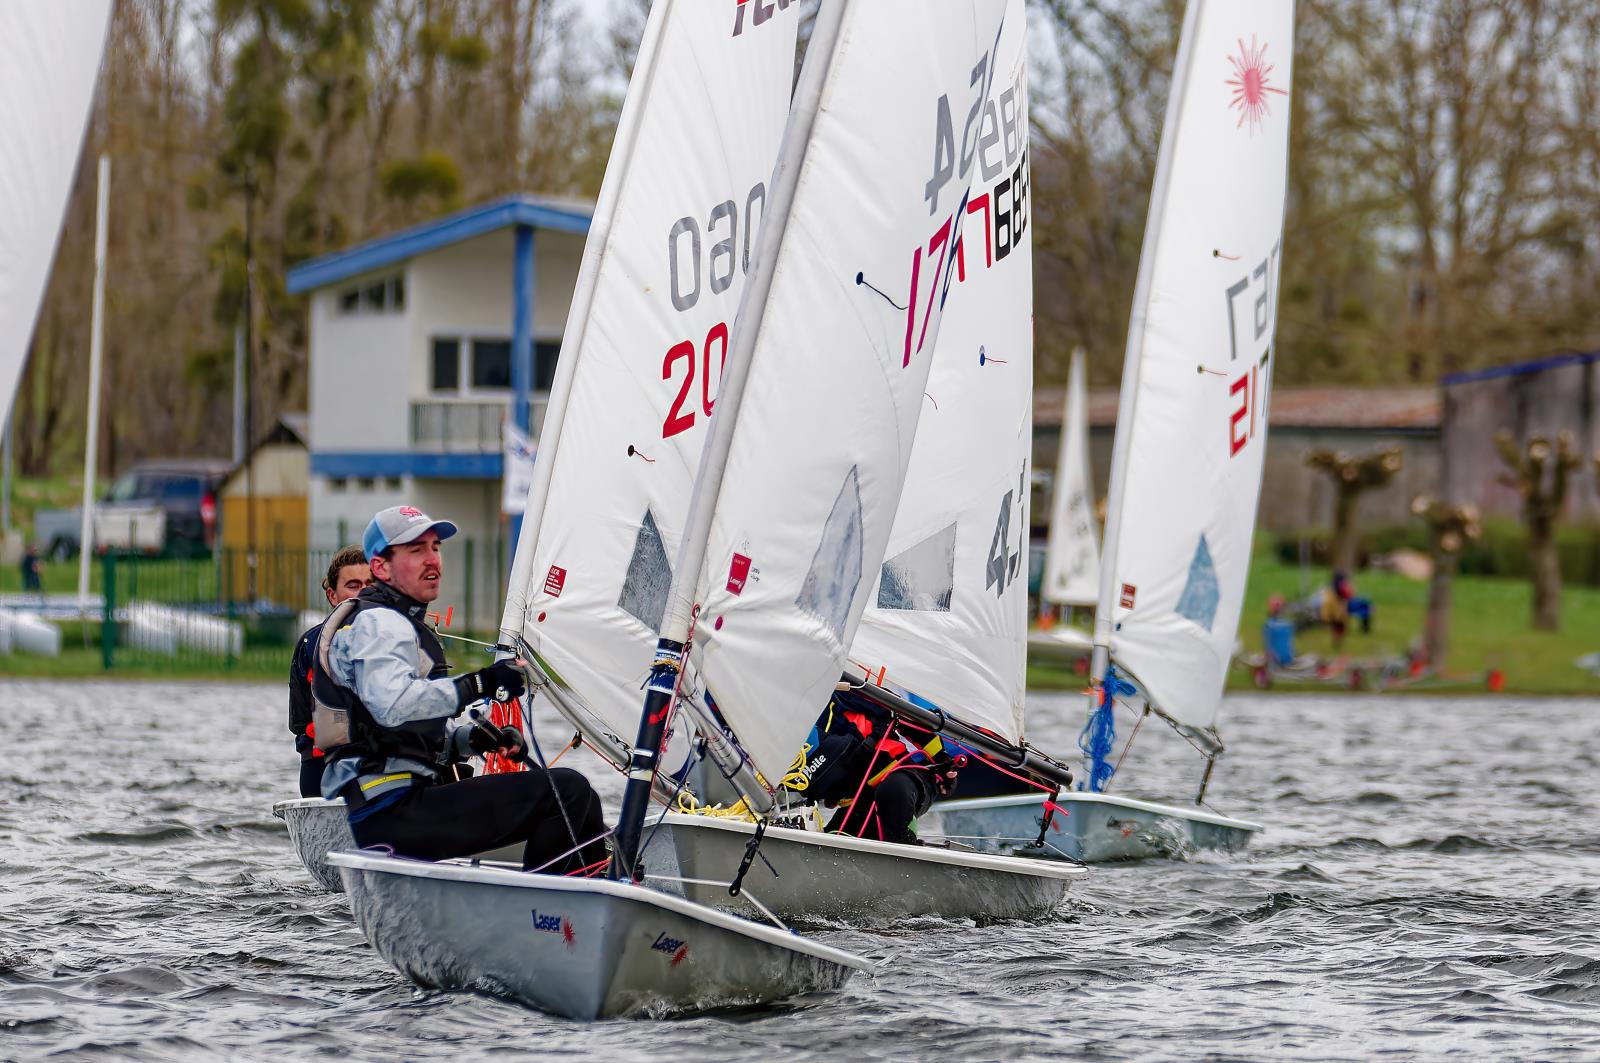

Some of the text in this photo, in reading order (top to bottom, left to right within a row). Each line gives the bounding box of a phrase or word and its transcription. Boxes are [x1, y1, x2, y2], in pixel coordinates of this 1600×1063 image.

[662, 321, 729, 439] 20
[531, 908, 561, 932] Laser
[651, 931, 685, 954] Laser
